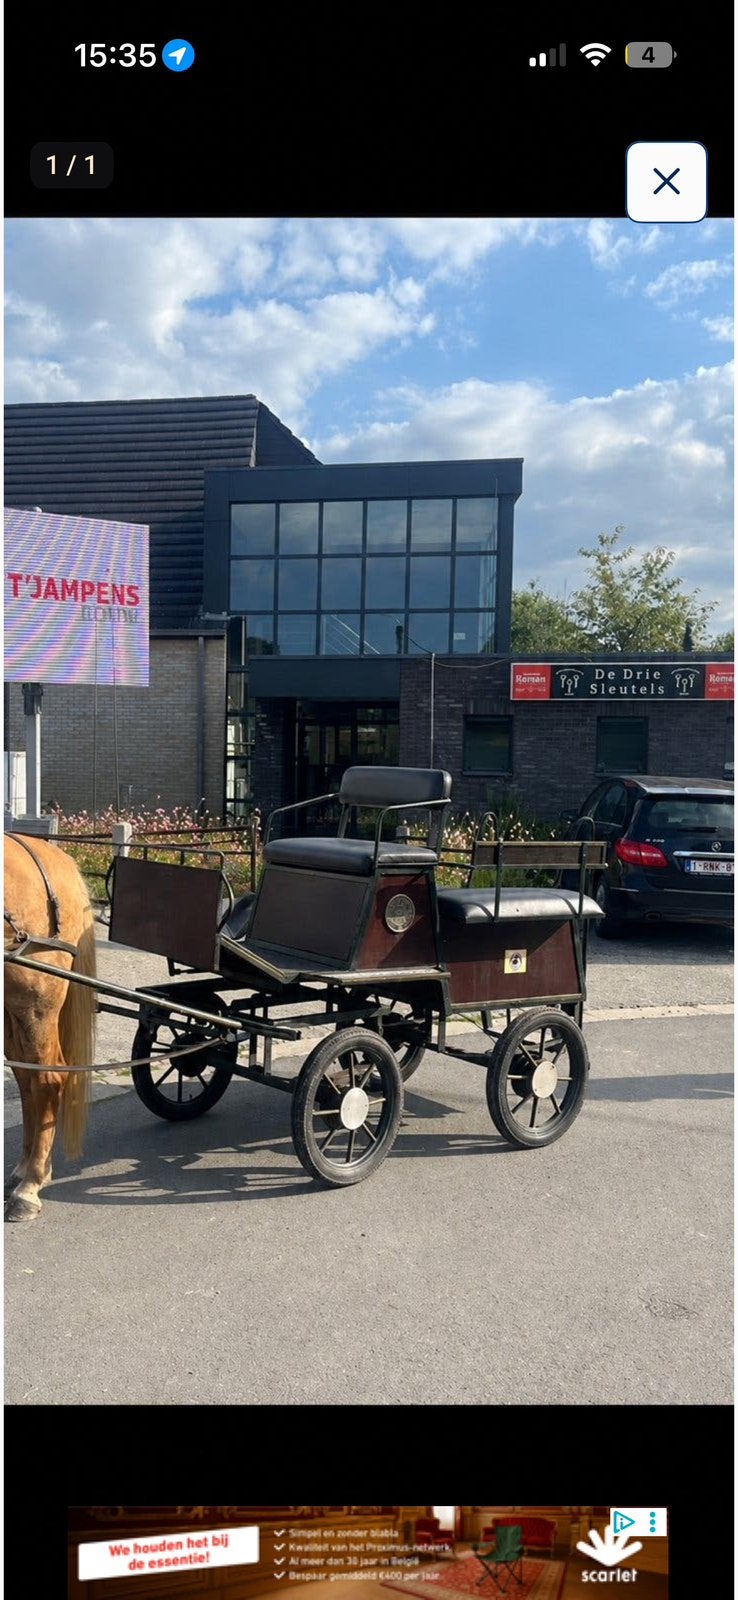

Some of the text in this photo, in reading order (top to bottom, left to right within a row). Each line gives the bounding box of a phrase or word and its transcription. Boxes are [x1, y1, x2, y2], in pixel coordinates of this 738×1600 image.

[7, 572, 140, 607] T'JAMPENS
[515, 674, 546, 684] Roman
[595, 668, 661, 680] De Drie
[590, 683, 665, 695] Sleutels
[693, 862, 734, 873] 1-RNK-8
